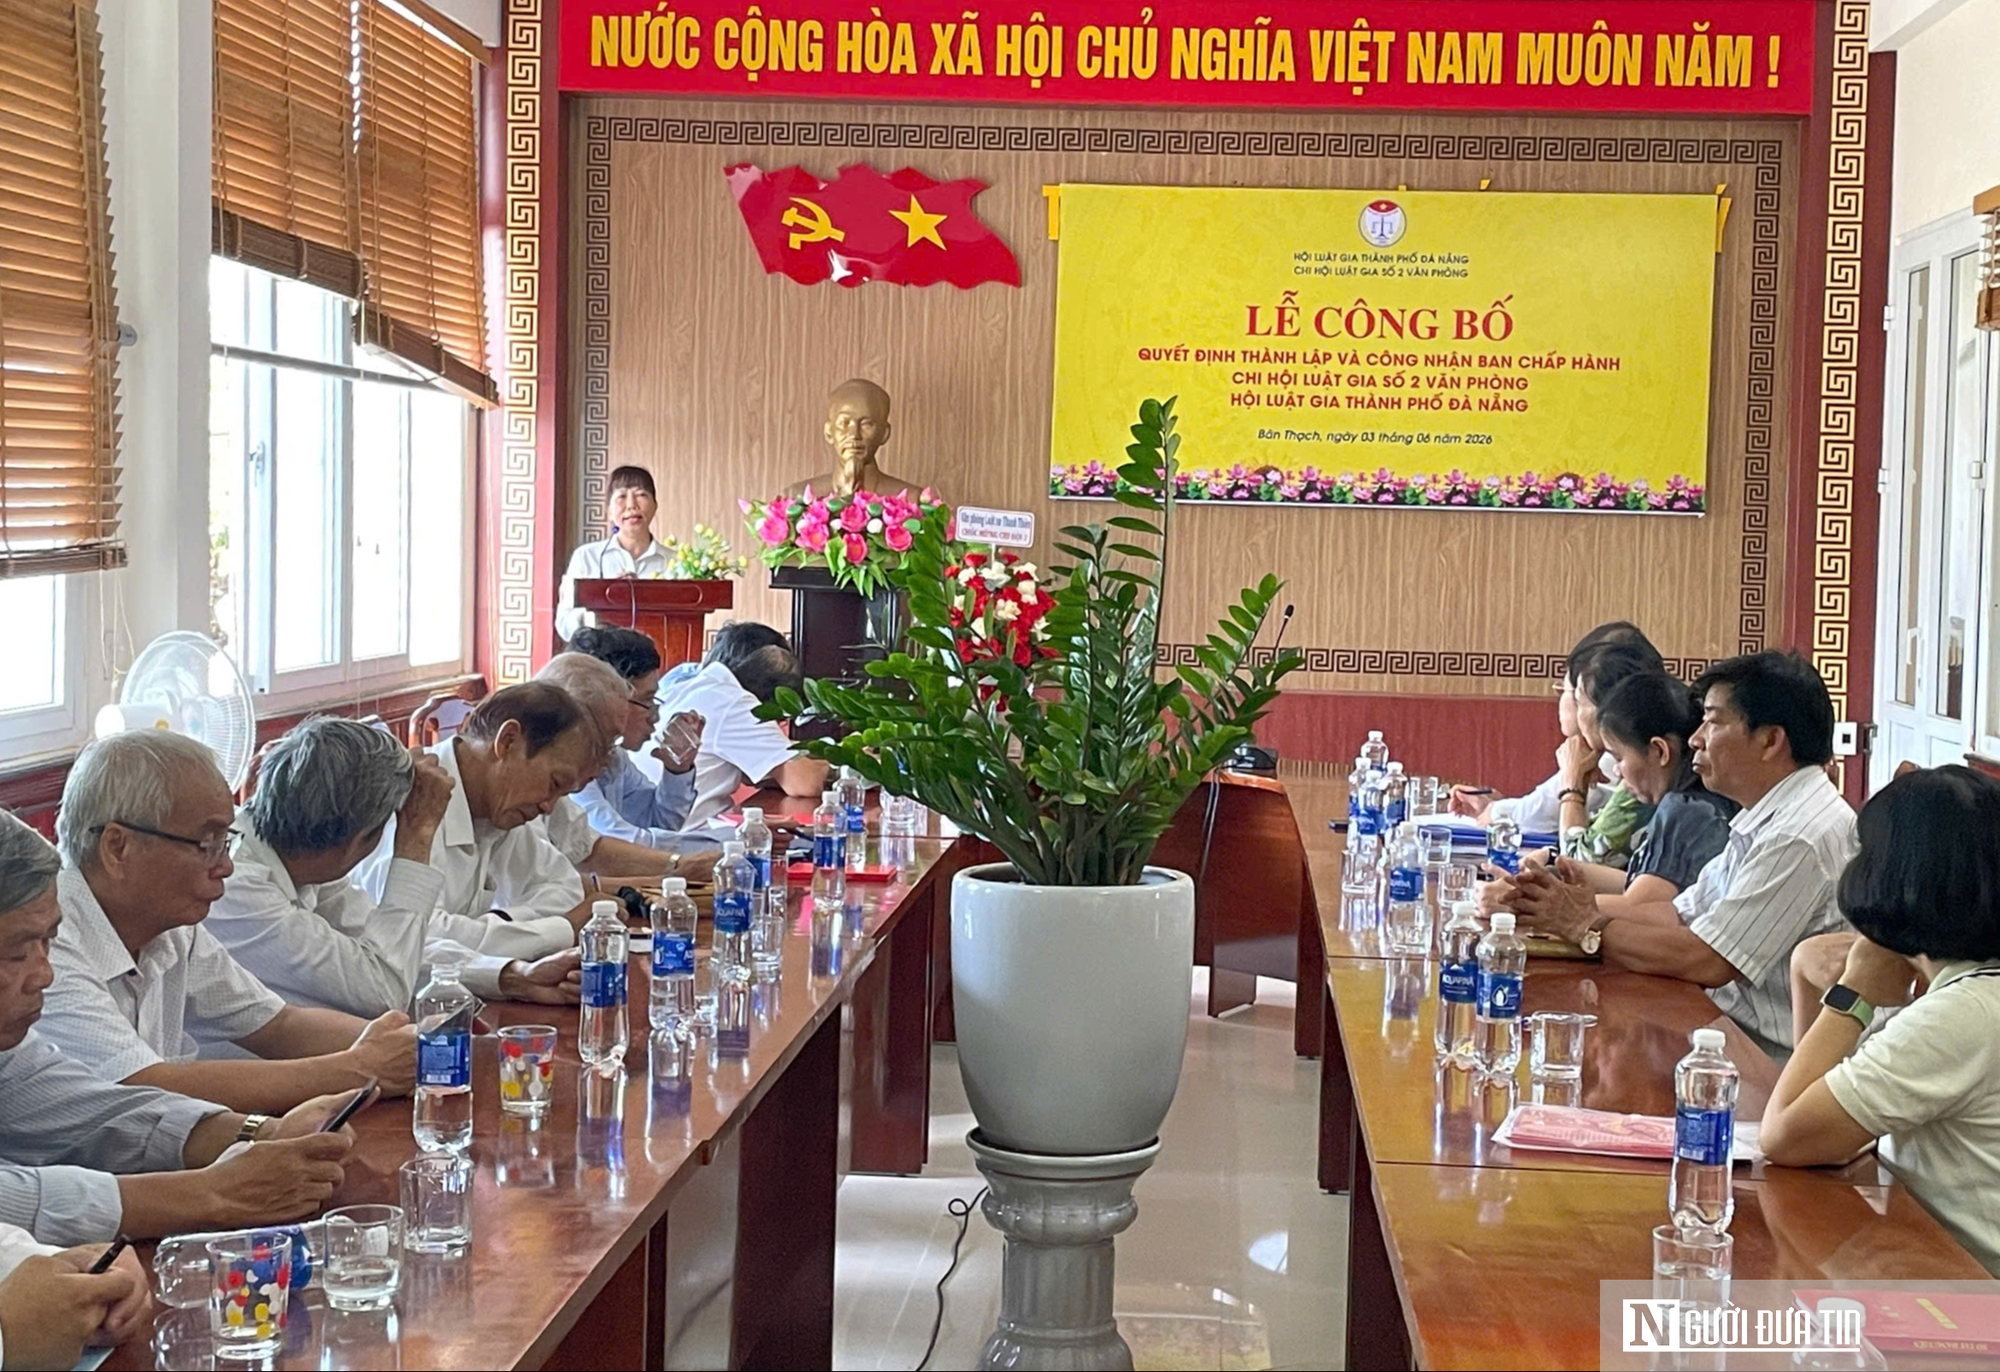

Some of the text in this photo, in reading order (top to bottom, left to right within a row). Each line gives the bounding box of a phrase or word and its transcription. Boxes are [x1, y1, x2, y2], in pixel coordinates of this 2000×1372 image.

[591, 2, 1779, 95] NƯỚC CỘNG HÒA XÃ HỘI CHỦ NGHĨA VIỆT NAM MUÔN NĂM !
[1294, 251, 1311, 262] HỘI
[1340, 254, 1358, 262] GIA
[1397, 252, 1417, 263] PHỐ
[1421, 252, 1435, 263] ĐÀ
[1294, 266, 1311, 275] CHI
[1314, 266, 1332, 276] HỘI
[1360, 268, 1378, 276] GIA
[1382, 265, 1395, 276] SỐ
[1408, 268, 1428, 277] VĂN
[1432, 268, 1468, 278] PHÒNG
[1245, 290, 1513, 341] LỄ CÔNG BỐ
[1138, 344, 1620, 372] QUYẾT ĐỊNH THÀNH LẬP VÀ CÔNG NHẬN BAN CHẤP HÀNH
[1232, 369, 1528, 390] CHI HỘI LUẬT GIA SỐ 2 VĂN PHÒNG
[1231, 390, 1528, 412] HỘI LUẬT GIA THÀNH PHỐ ĐÀ NẴNG
[1327, 432, 1358, 443] ngày
[1361, 432, 1374, 442] 03
[1379, 432, 1414, 445] tháng
[1417, 433, 1430, 443] 06
[1434, 434, 1461, 443] năm
[1465, 434, 1492, 444] 2026
